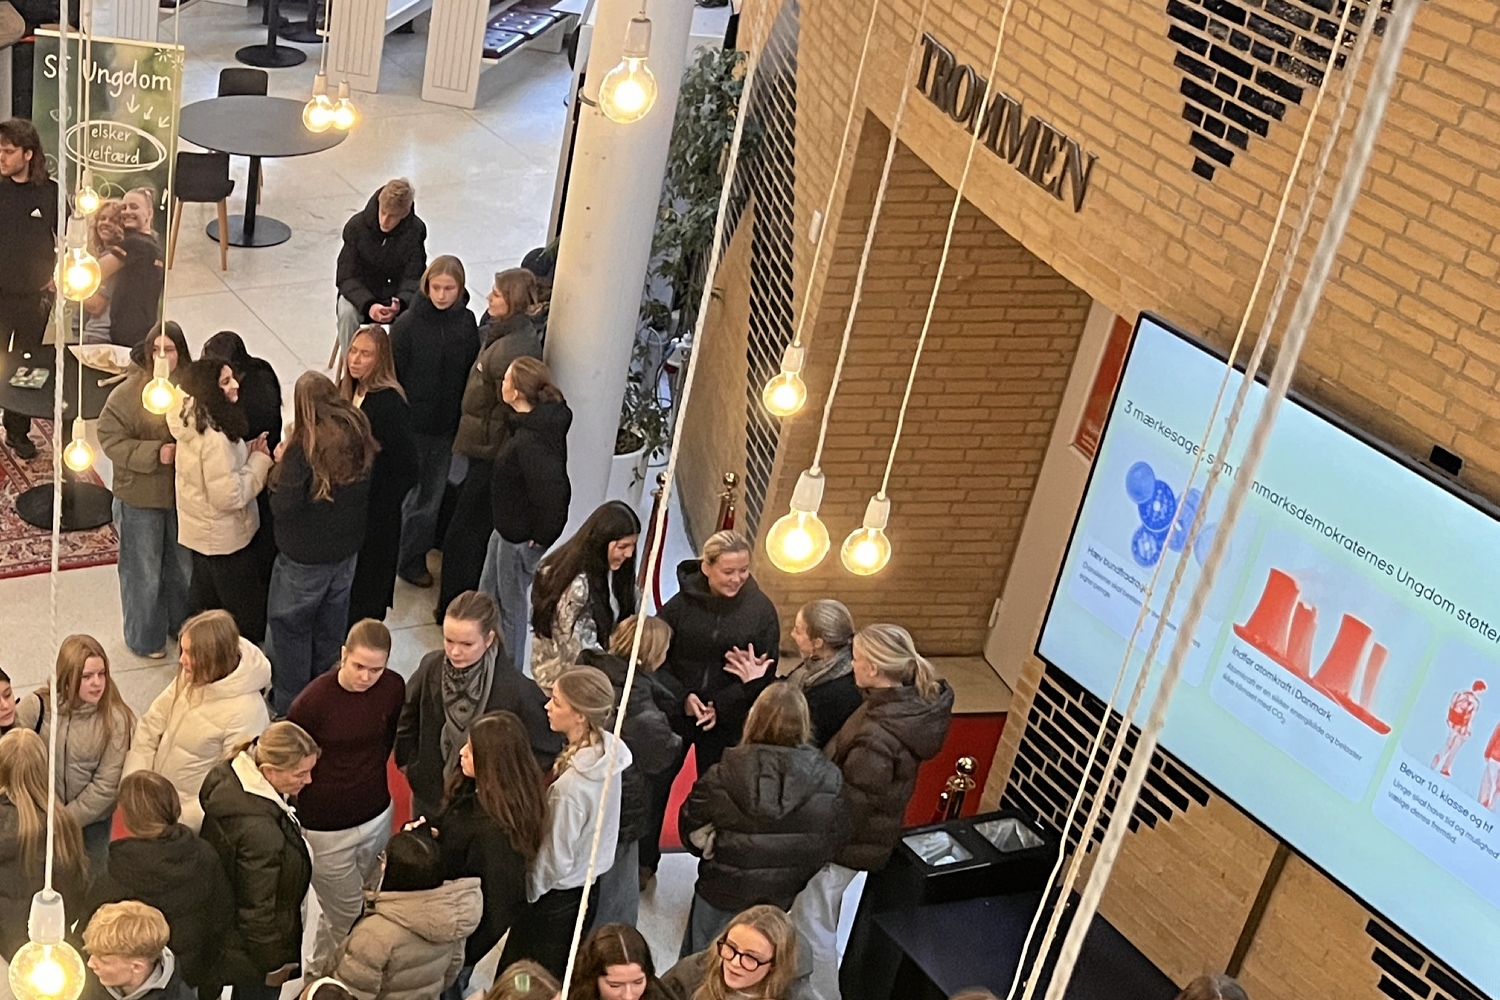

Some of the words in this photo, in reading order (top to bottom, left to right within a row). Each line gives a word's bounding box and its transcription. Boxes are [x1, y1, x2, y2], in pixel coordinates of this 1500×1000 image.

[82, 58, 172, 97] Ungdom
[91, 123, 132, 142] elsker
[916, 31, 1099, 213] TROMMEN
[1124, 400, 1133, 414] 3
[1206, 453, 1233, 477] sm
[1234, 467, 1395, 576] nmarksdemokraternes
[1396, 567, 1456, 614] Ungdom
[1254, 662, 1292, 693] atomkraft
[1294, 689, 1333, 722] Danmark
[1393, 778, 1412, 796] Unge
[1412, 794, 1427, 807] skal
[1427, 803, 1445, 820] have
[1444, 815, 1456, 828] tid
[1454, 824, 1465, 836] og
[1399, 762, 1426, 786] Bevar
[1427, 781, 1439, 797] 10.
[1440, 789, 1469, 817] klasse
[1469, 814, 1483, 828] og
